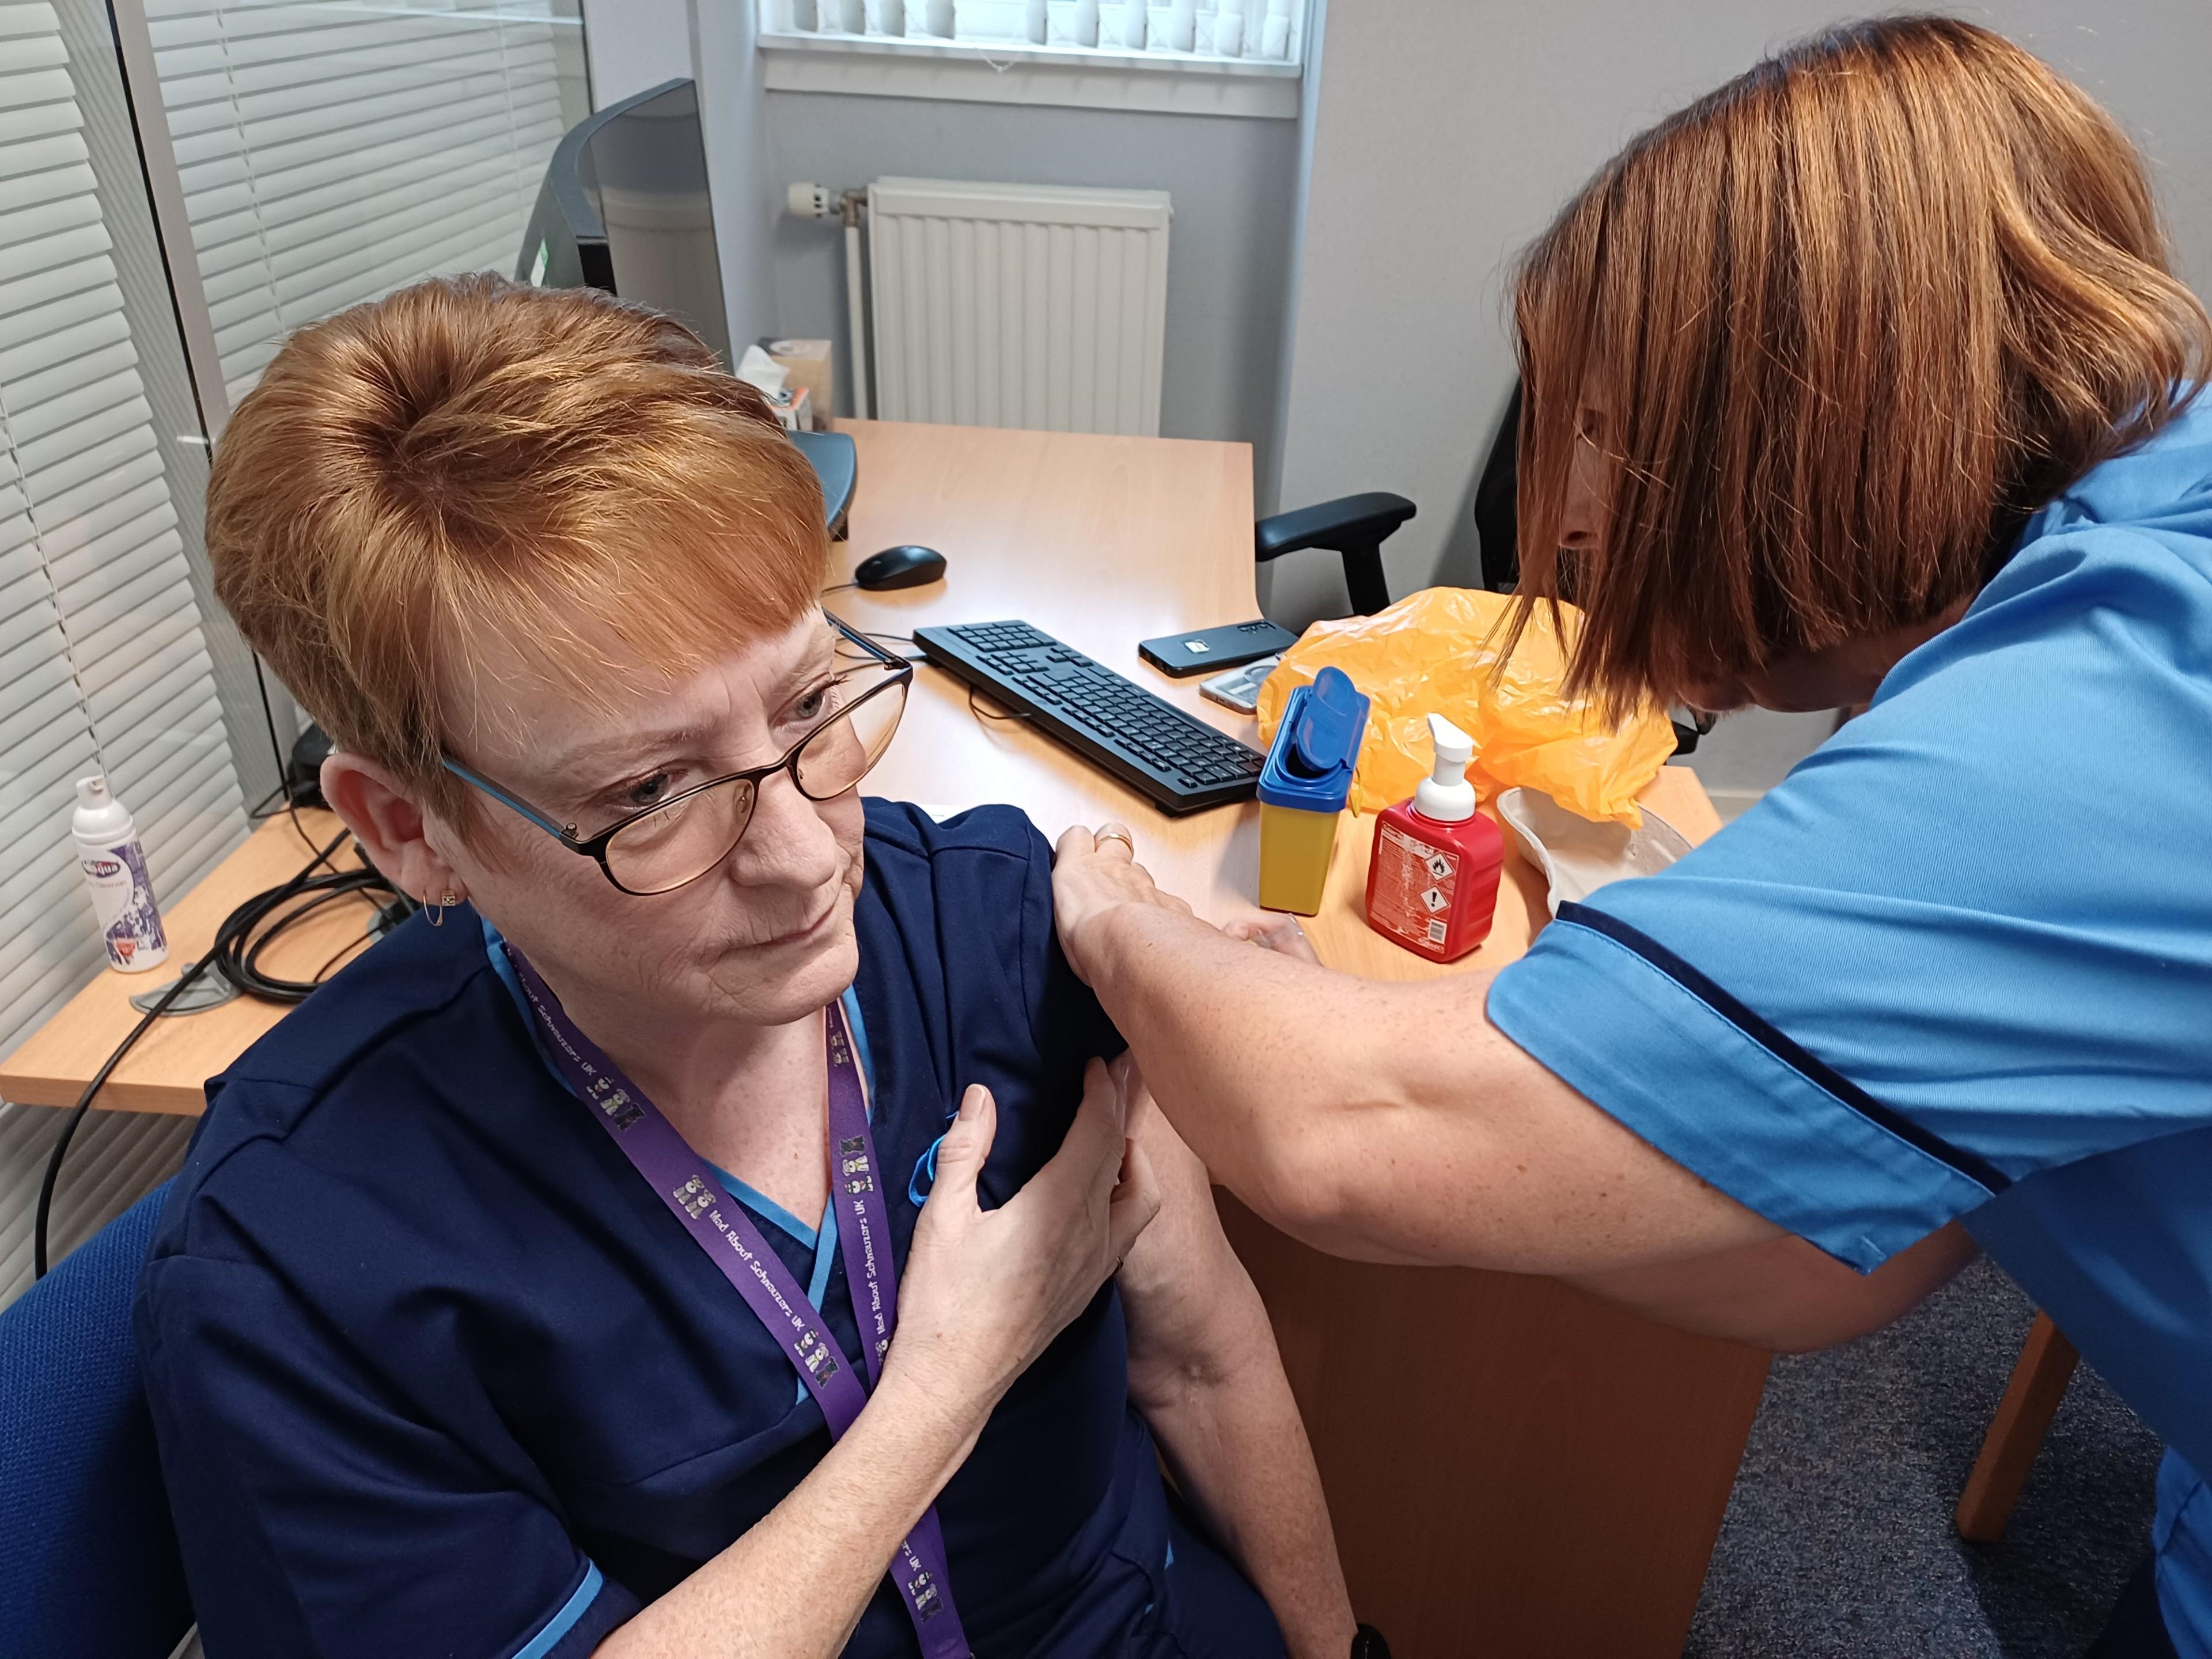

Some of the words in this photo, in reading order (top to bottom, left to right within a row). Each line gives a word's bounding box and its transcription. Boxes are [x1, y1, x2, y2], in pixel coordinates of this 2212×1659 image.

[538, 1005, 581, 1062] Schnauzers
[581, 1062, 597, 1076] UK
[853, 1199, 865, 1215] UK
[859, 1217, 876, 1279] Schnauzers
[709, 1210, 729, 1232] Mad
[725, 1230, 753, 1260] About
[750, 1260, 793, 1317] Schnauzers
[791, 1315, 805, 1332] UK
[868, 1281, 881, 1312] About
[874, 1312, 886, 1335] Mad
[909, 1555, 922, 1571] UK
